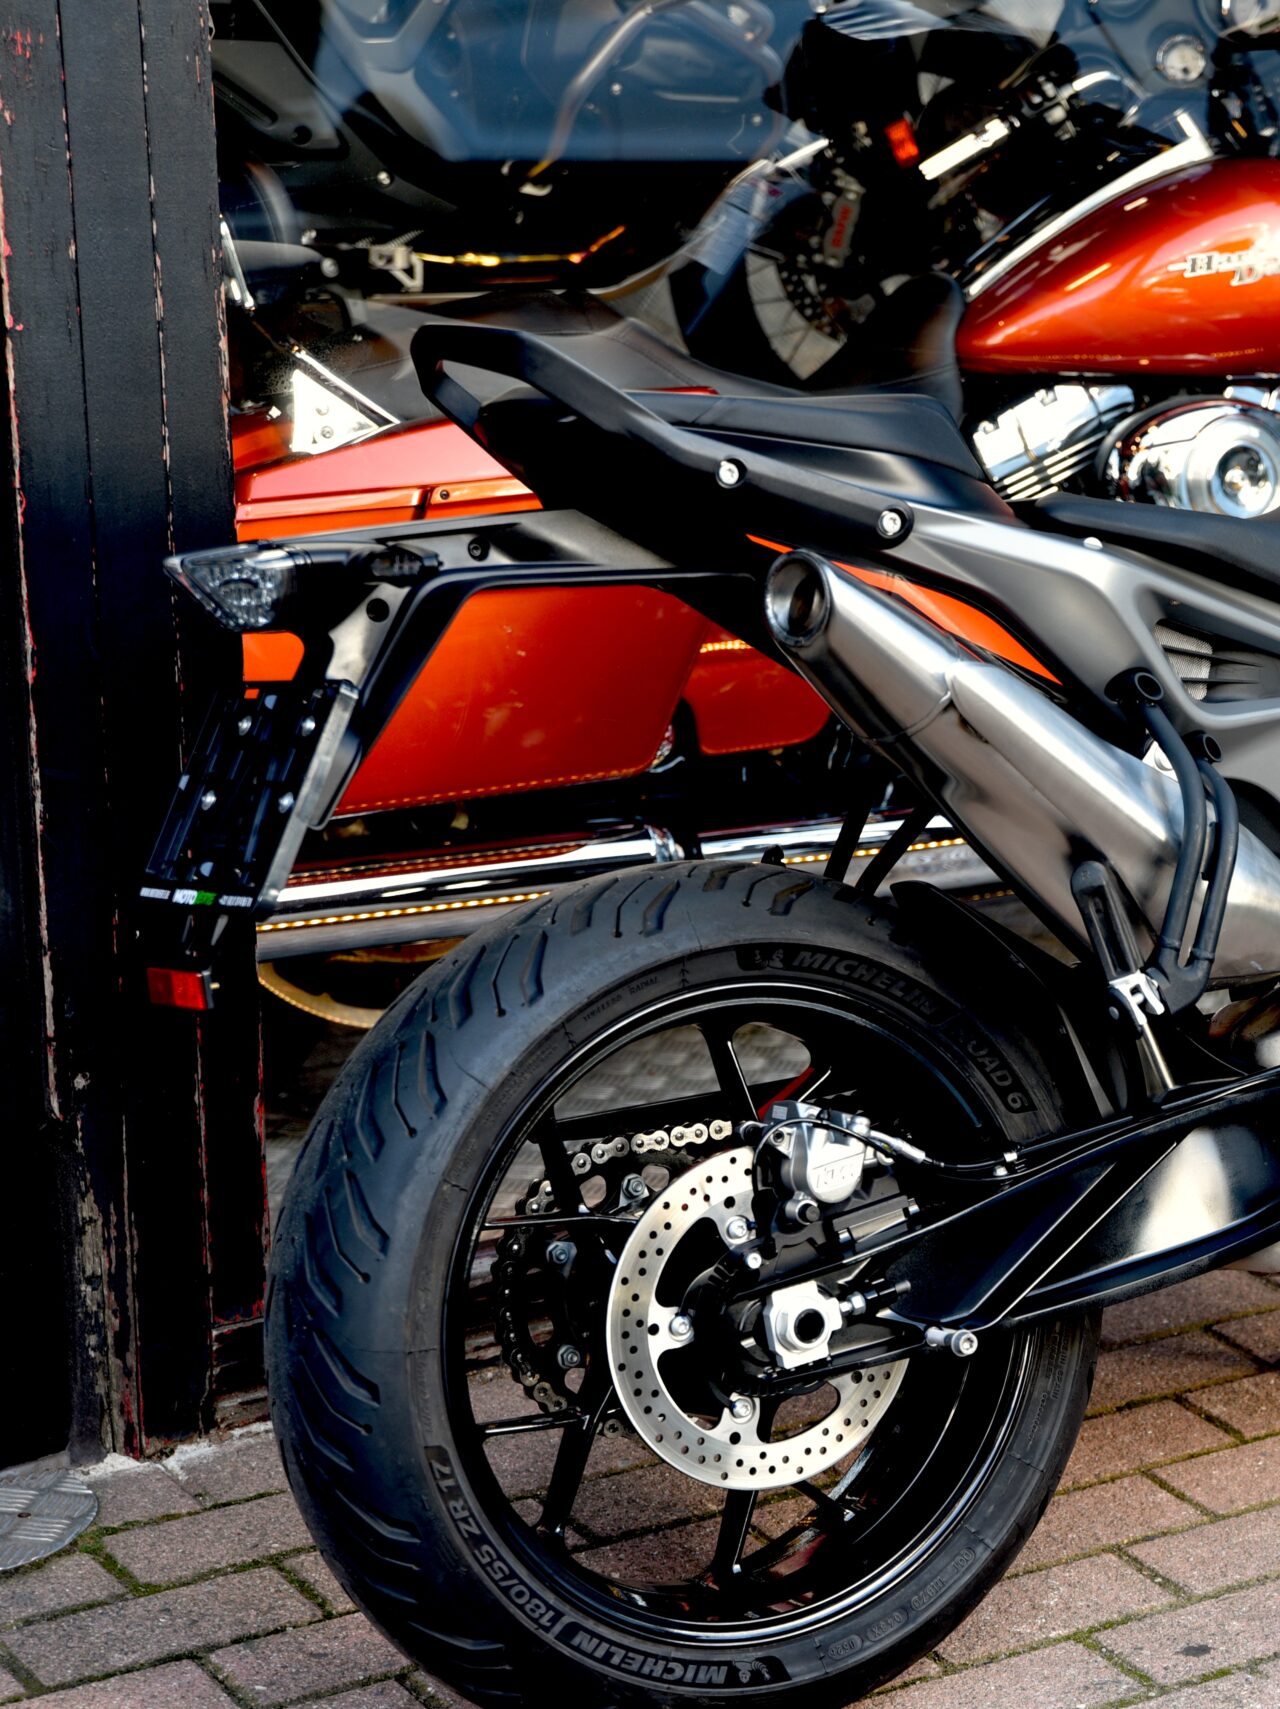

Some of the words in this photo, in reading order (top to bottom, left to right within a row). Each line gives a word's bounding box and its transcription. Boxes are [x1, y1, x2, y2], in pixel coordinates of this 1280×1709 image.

[792, 949, 937, 1017] MICHELIN
[1007, 1093, 1029, 1111] 6
[430, 1459, 456, 1493] 17
[448, 1498, 482, 1538] ZR
[474, 1543, 557, 1627] 180/55
[570, 1629, 728, 1685] MICHELIN
